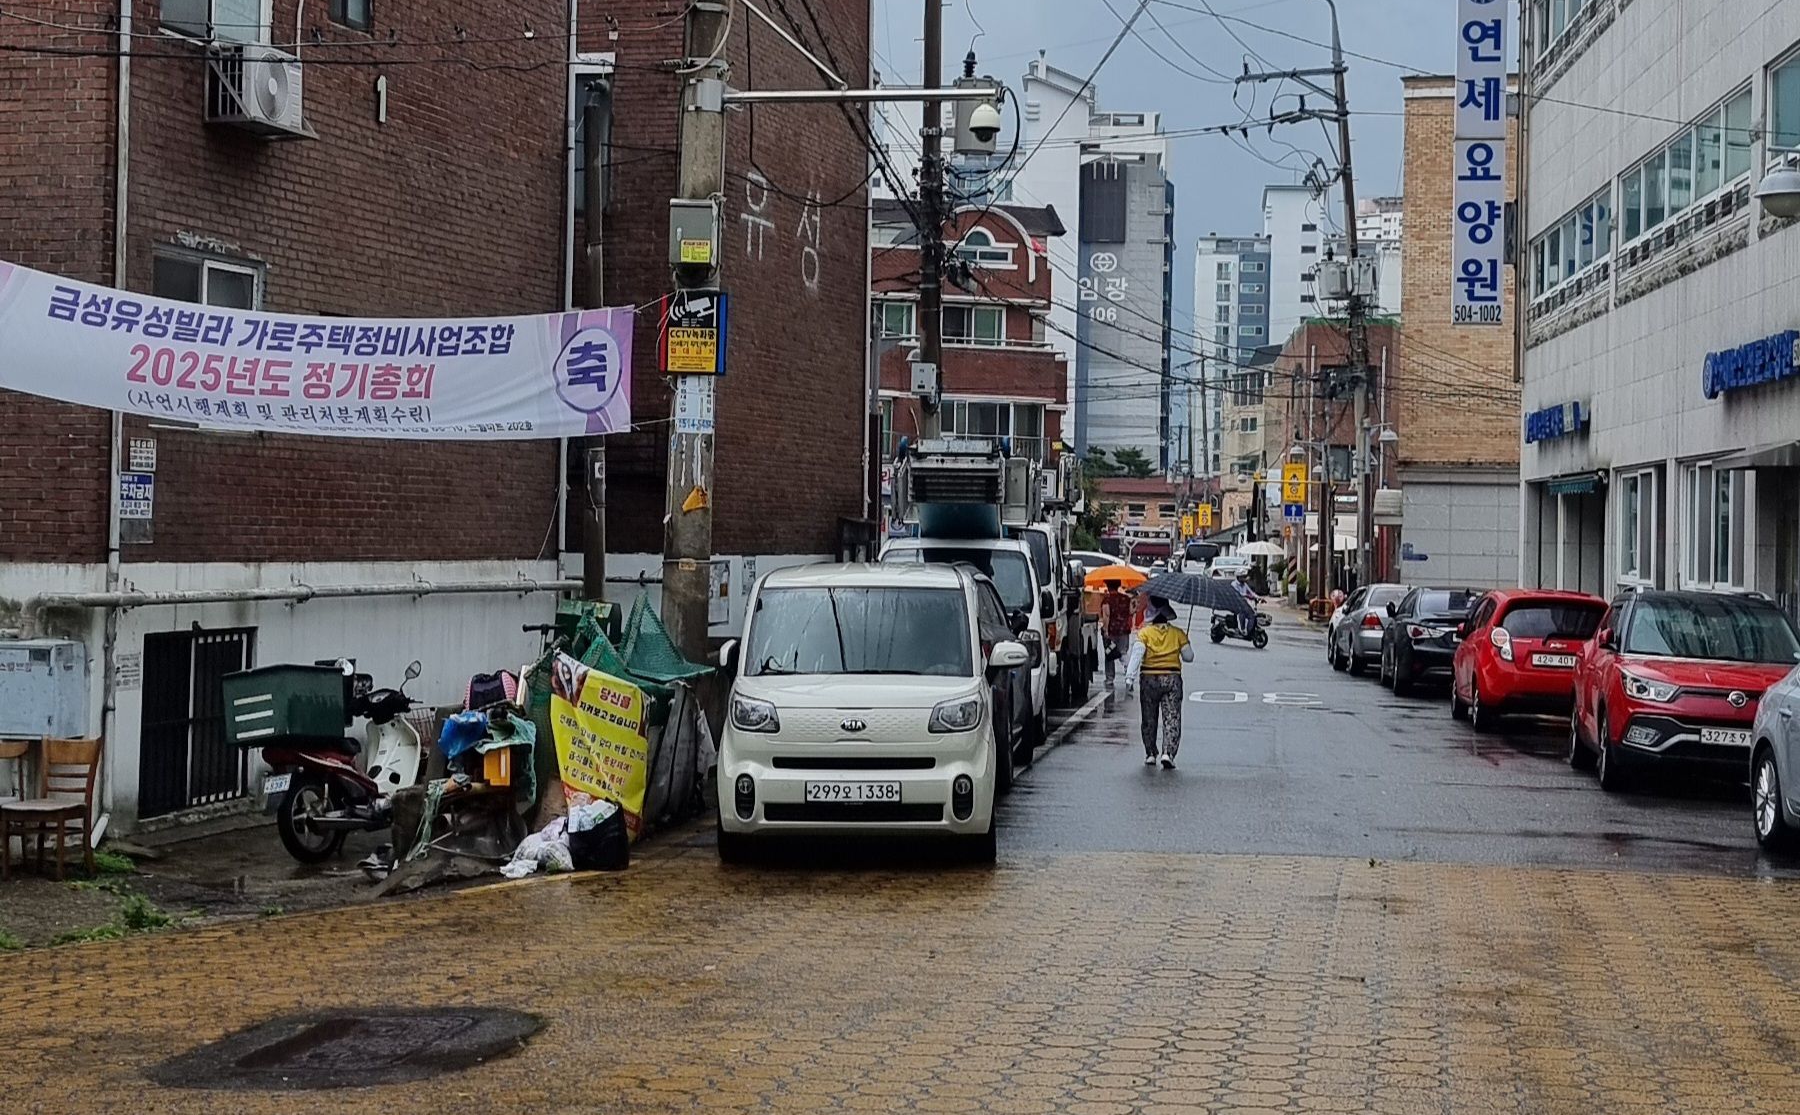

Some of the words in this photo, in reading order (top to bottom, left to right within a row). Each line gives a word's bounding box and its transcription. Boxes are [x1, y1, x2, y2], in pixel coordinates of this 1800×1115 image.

[1457, 18, 1502, 303] 연세요양원
[1078, 276, 1129, 302] 임광
[48, 285, 234, 347] 금성유성빌라
[237, 319, 515, 358] 가로주택정비사업조합
[1087, 306, 1118, 323] 106
[1454, 304, 1502, 323] 504-1002
[126, 343, 293, 397] 2025년도
[303, 362, 436, 400] 정기총회
[566, 341, 608, 393] 축
[127, 389, 250, 420] (사업시행계획
[256, 402, 275, 423] 및
[1558, 657, 1574, 665] 401
[842, 719, 863, 730] KIA
[1705, 730, 1737, 743] 327조
[812, 784, 853, 799] 299오
[856, 784, 895, 799] 1338
